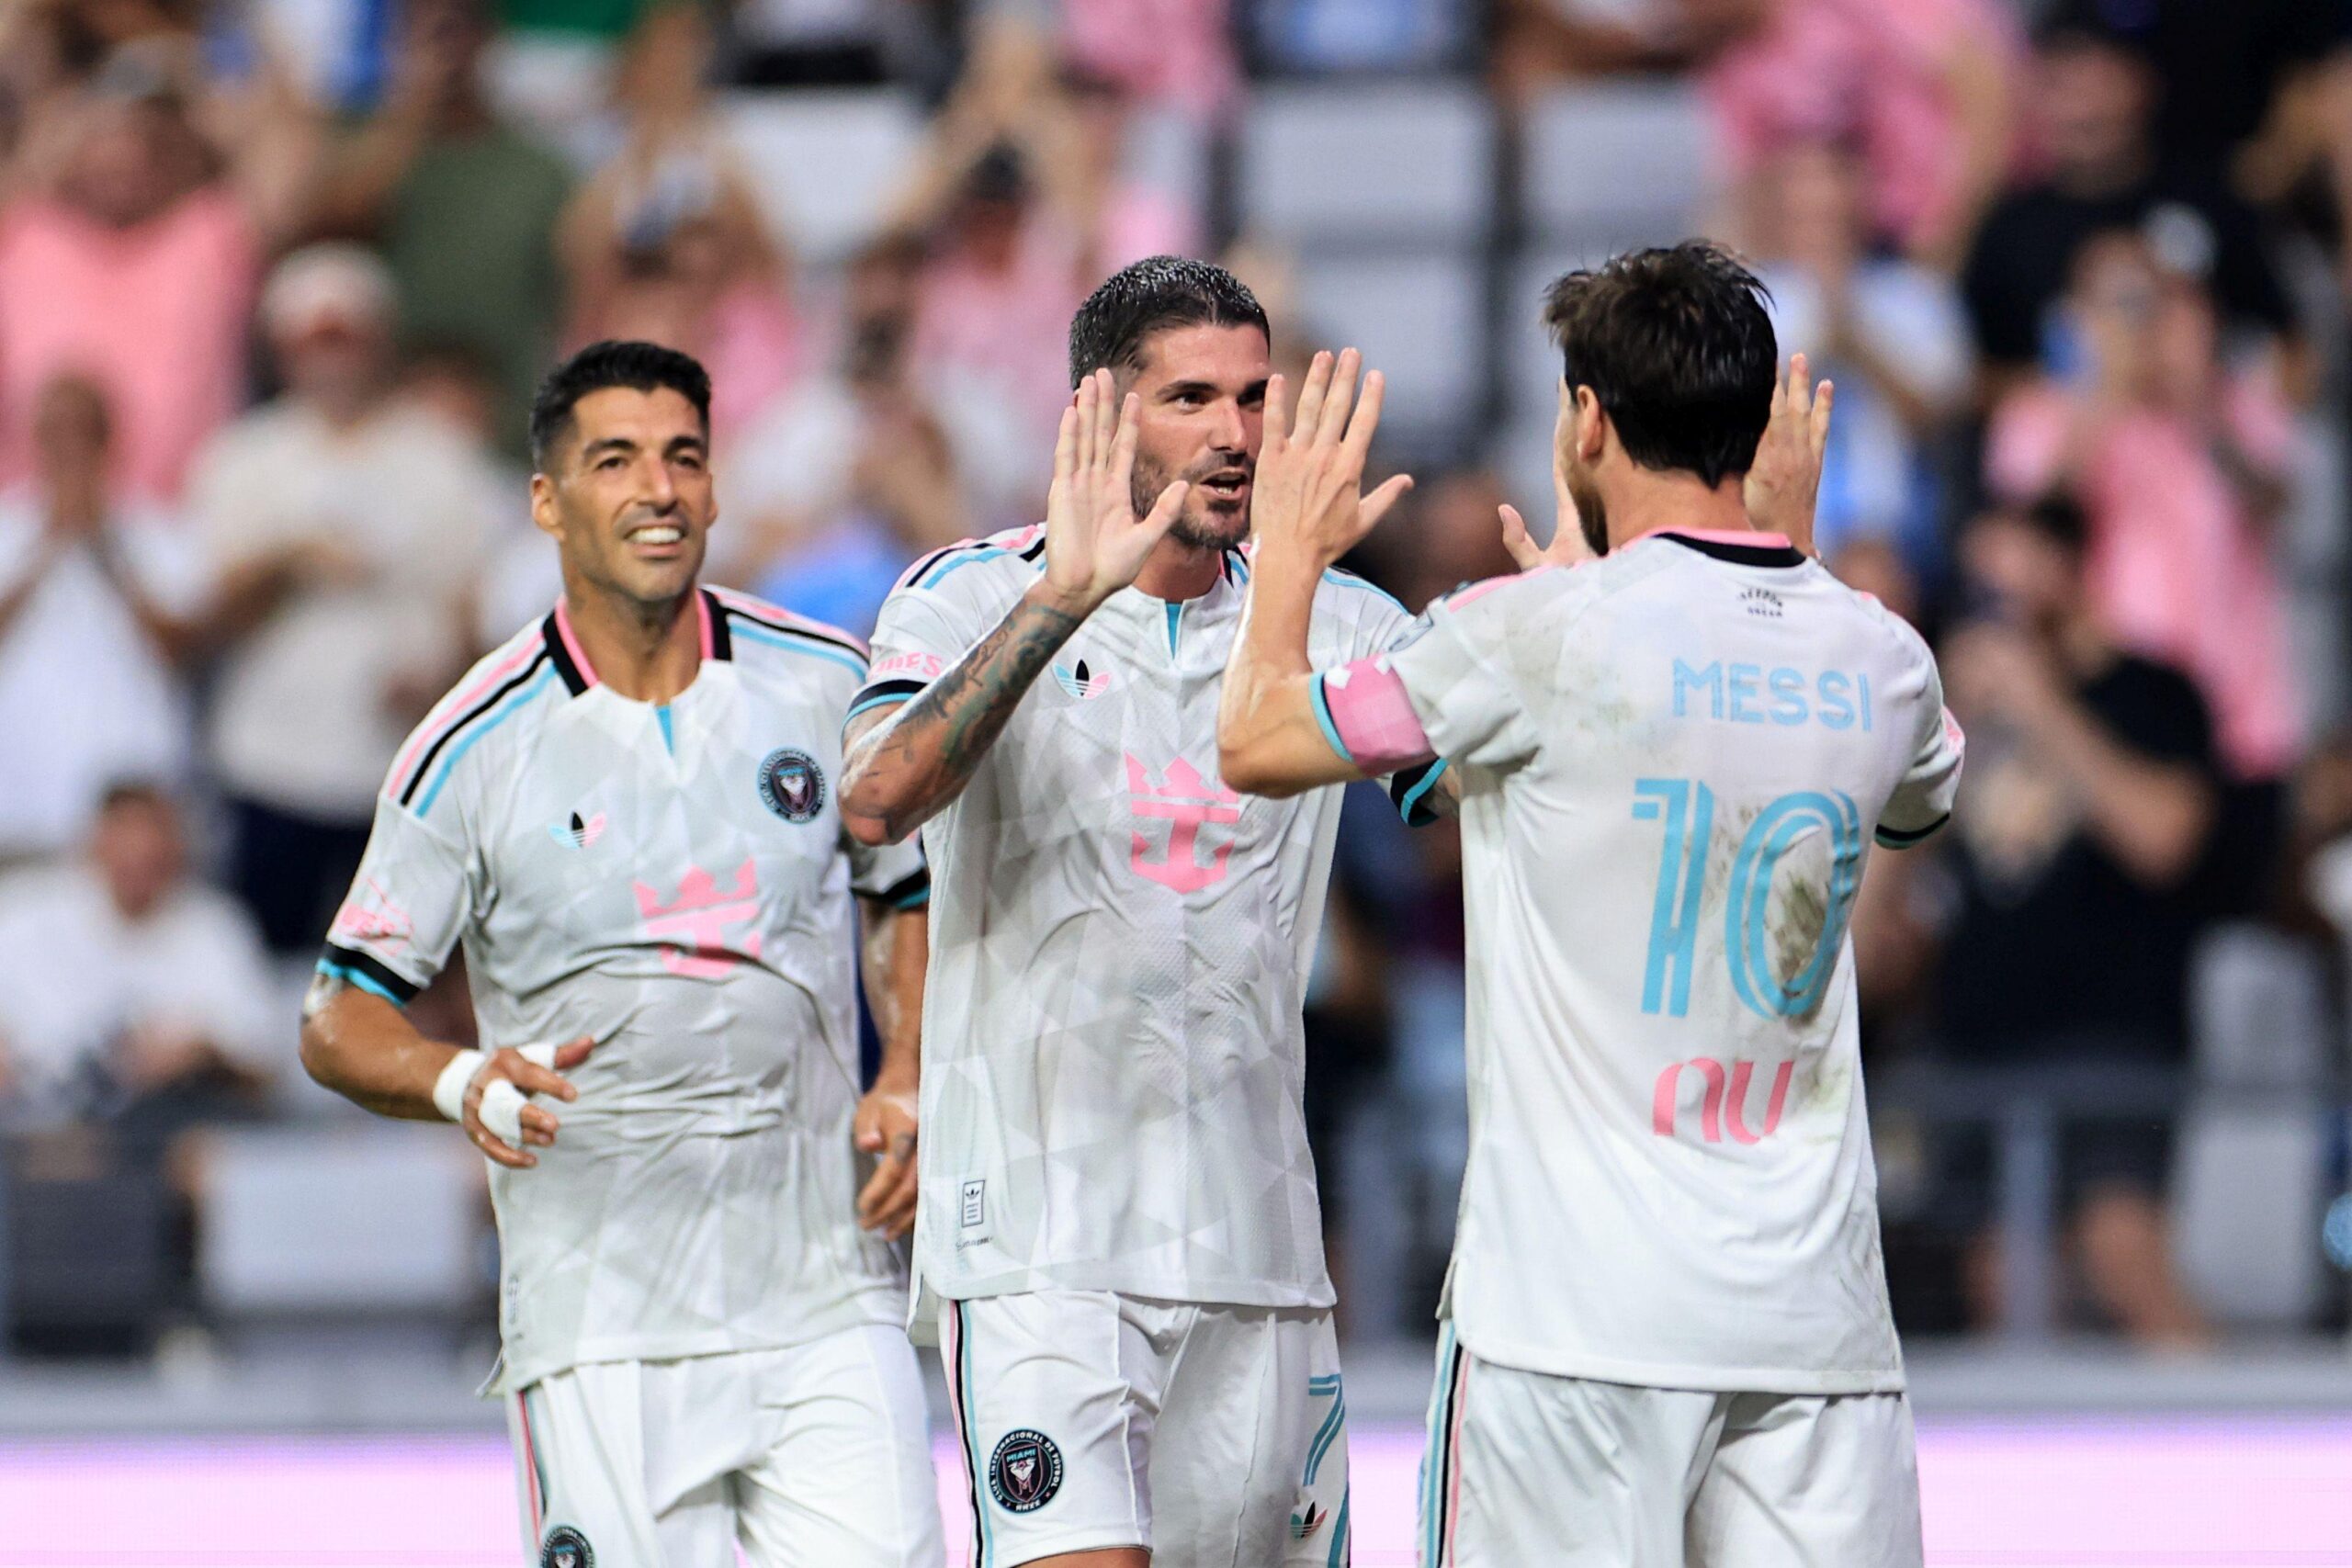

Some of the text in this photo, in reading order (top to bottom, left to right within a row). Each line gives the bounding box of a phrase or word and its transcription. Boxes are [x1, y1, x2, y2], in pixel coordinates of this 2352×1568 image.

[1673, 656, 1872, 732] MESSI
[1632, 778, 1860, 1021] 10
[1045, 1443, 1055, 1452] DE
[1303, 1373, 1346, 1487] 7
[990, 1432, 1044, 1475] INTERNACIONAL
[1006, 1449, 1035, 1462] MIAMI
[991, 1480, 1002, 1500] CLUB
